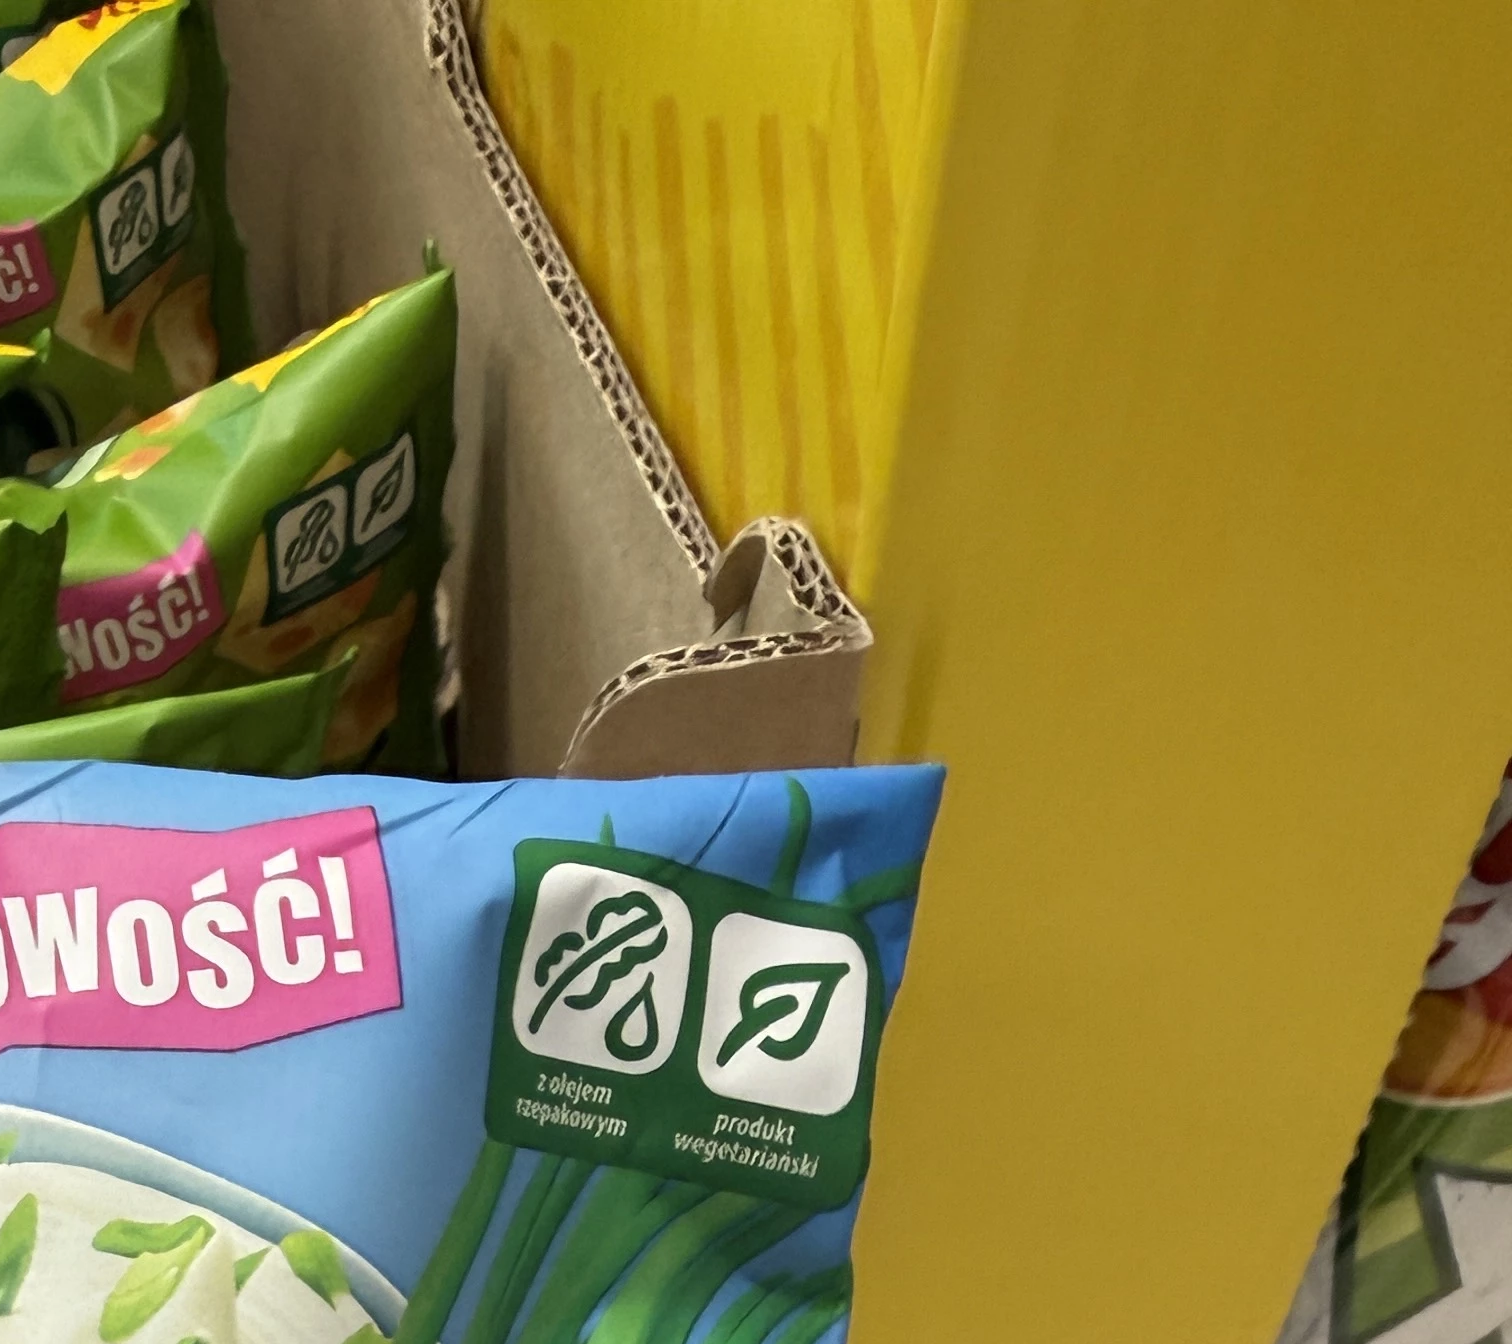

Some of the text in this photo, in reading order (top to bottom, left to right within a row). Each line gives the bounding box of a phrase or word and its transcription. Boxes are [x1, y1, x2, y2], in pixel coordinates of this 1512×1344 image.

[549, 1071, 613, 1105] olejem
[515, 1097, 628, 1139] rzepakowym
[712, 1112, 797, 1146] produkt
[673, 1130, 821, 1180] wegetariański
